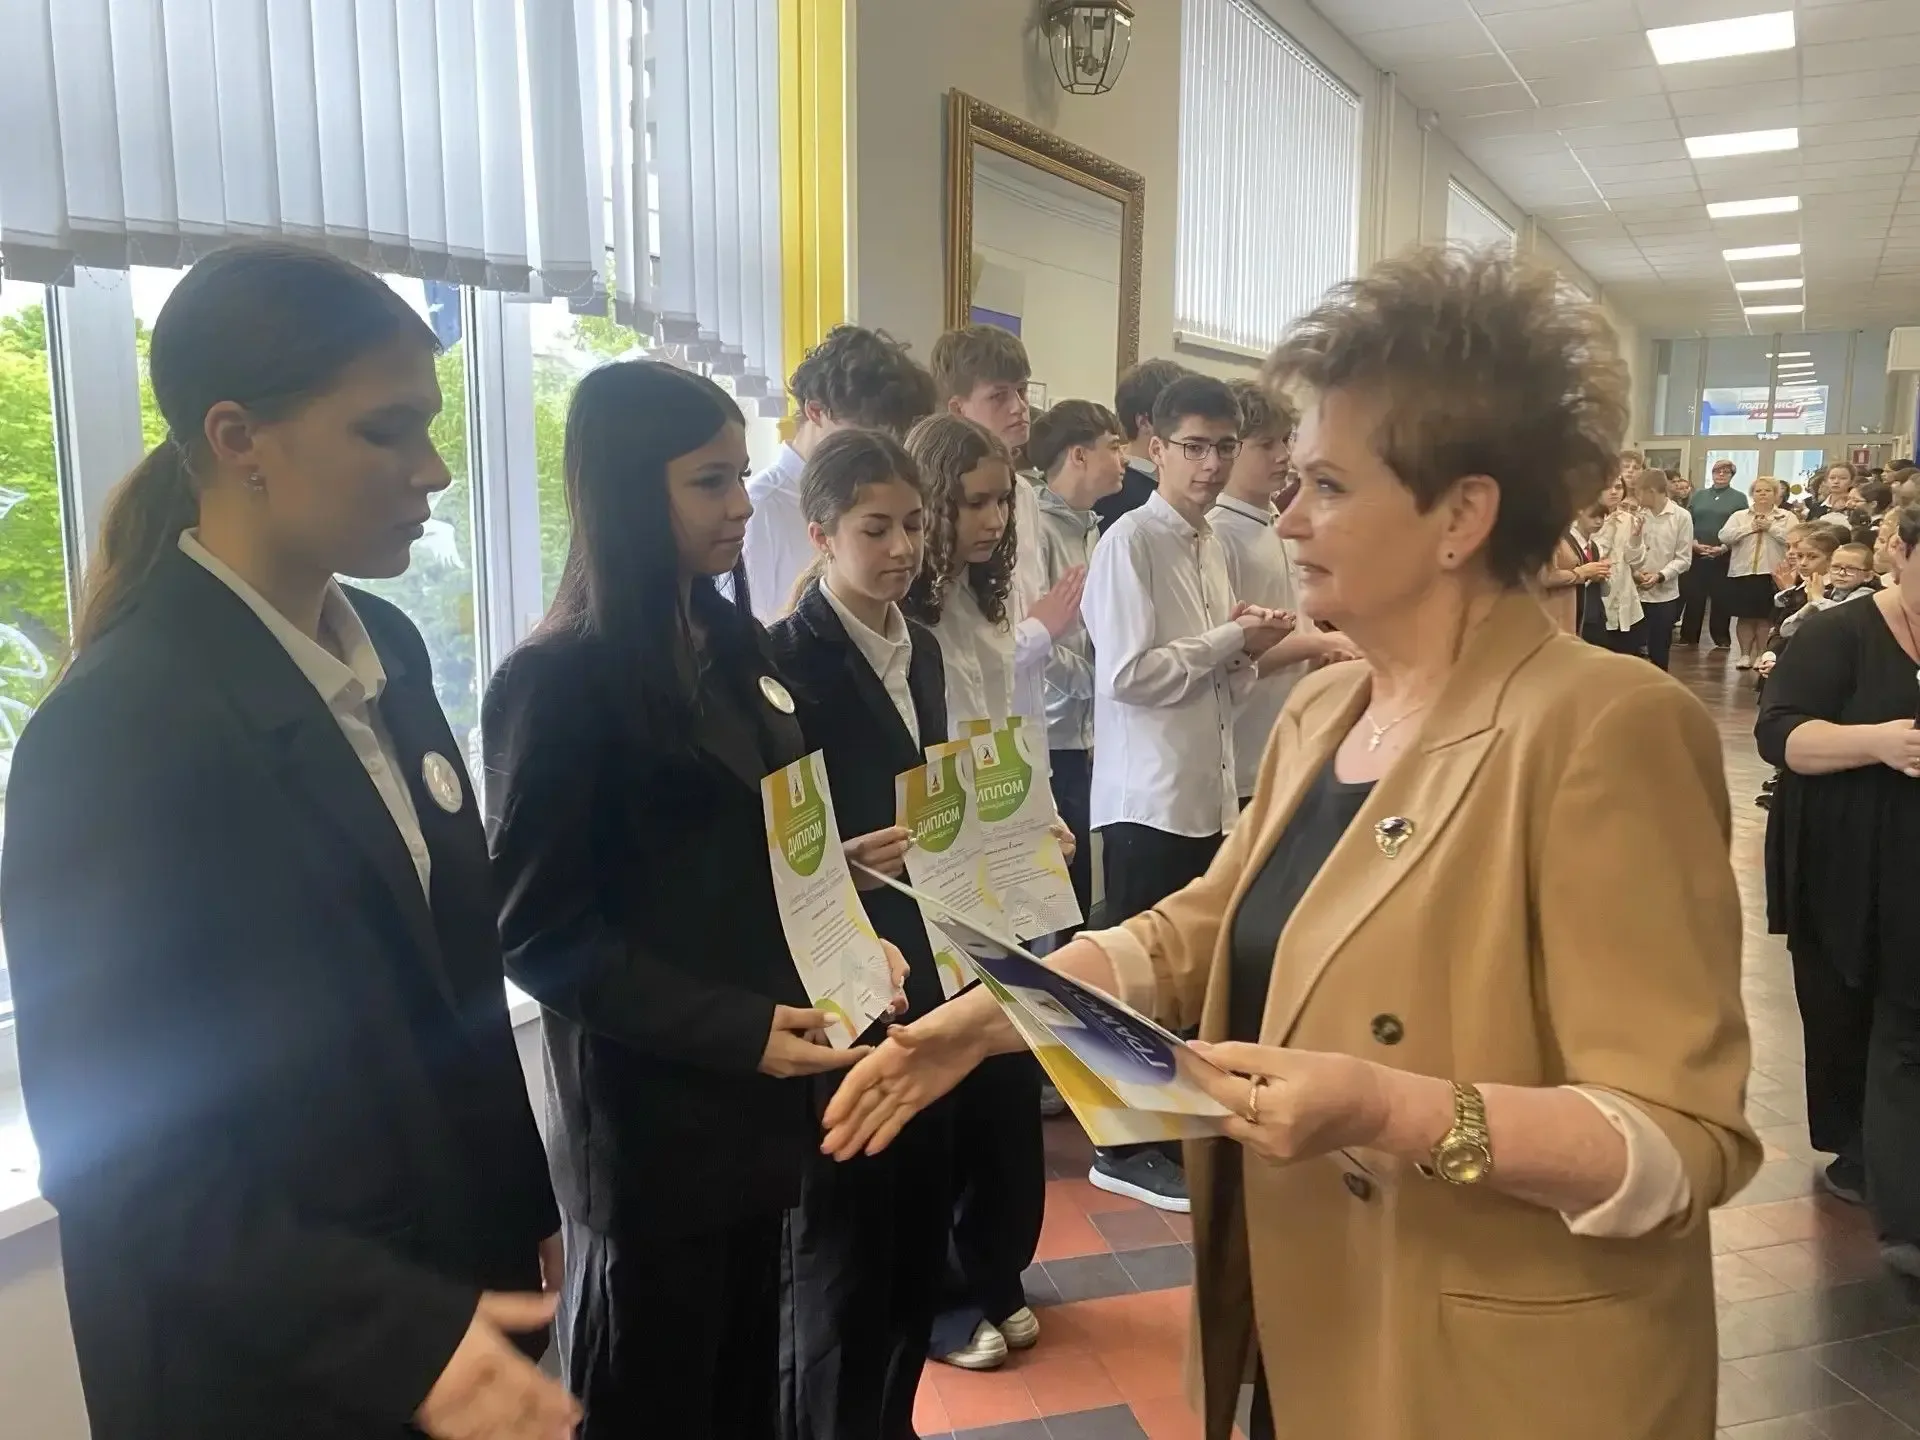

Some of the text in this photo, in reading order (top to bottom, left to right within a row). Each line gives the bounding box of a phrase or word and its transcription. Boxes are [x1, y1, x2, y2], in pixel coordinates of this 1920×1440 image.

[976, 779, 1024, 804] ИПЛОМ
[916, 805, 960, 839] ДИПЛОМ
[788, 820, 823, 861] ДИПЛОМ
